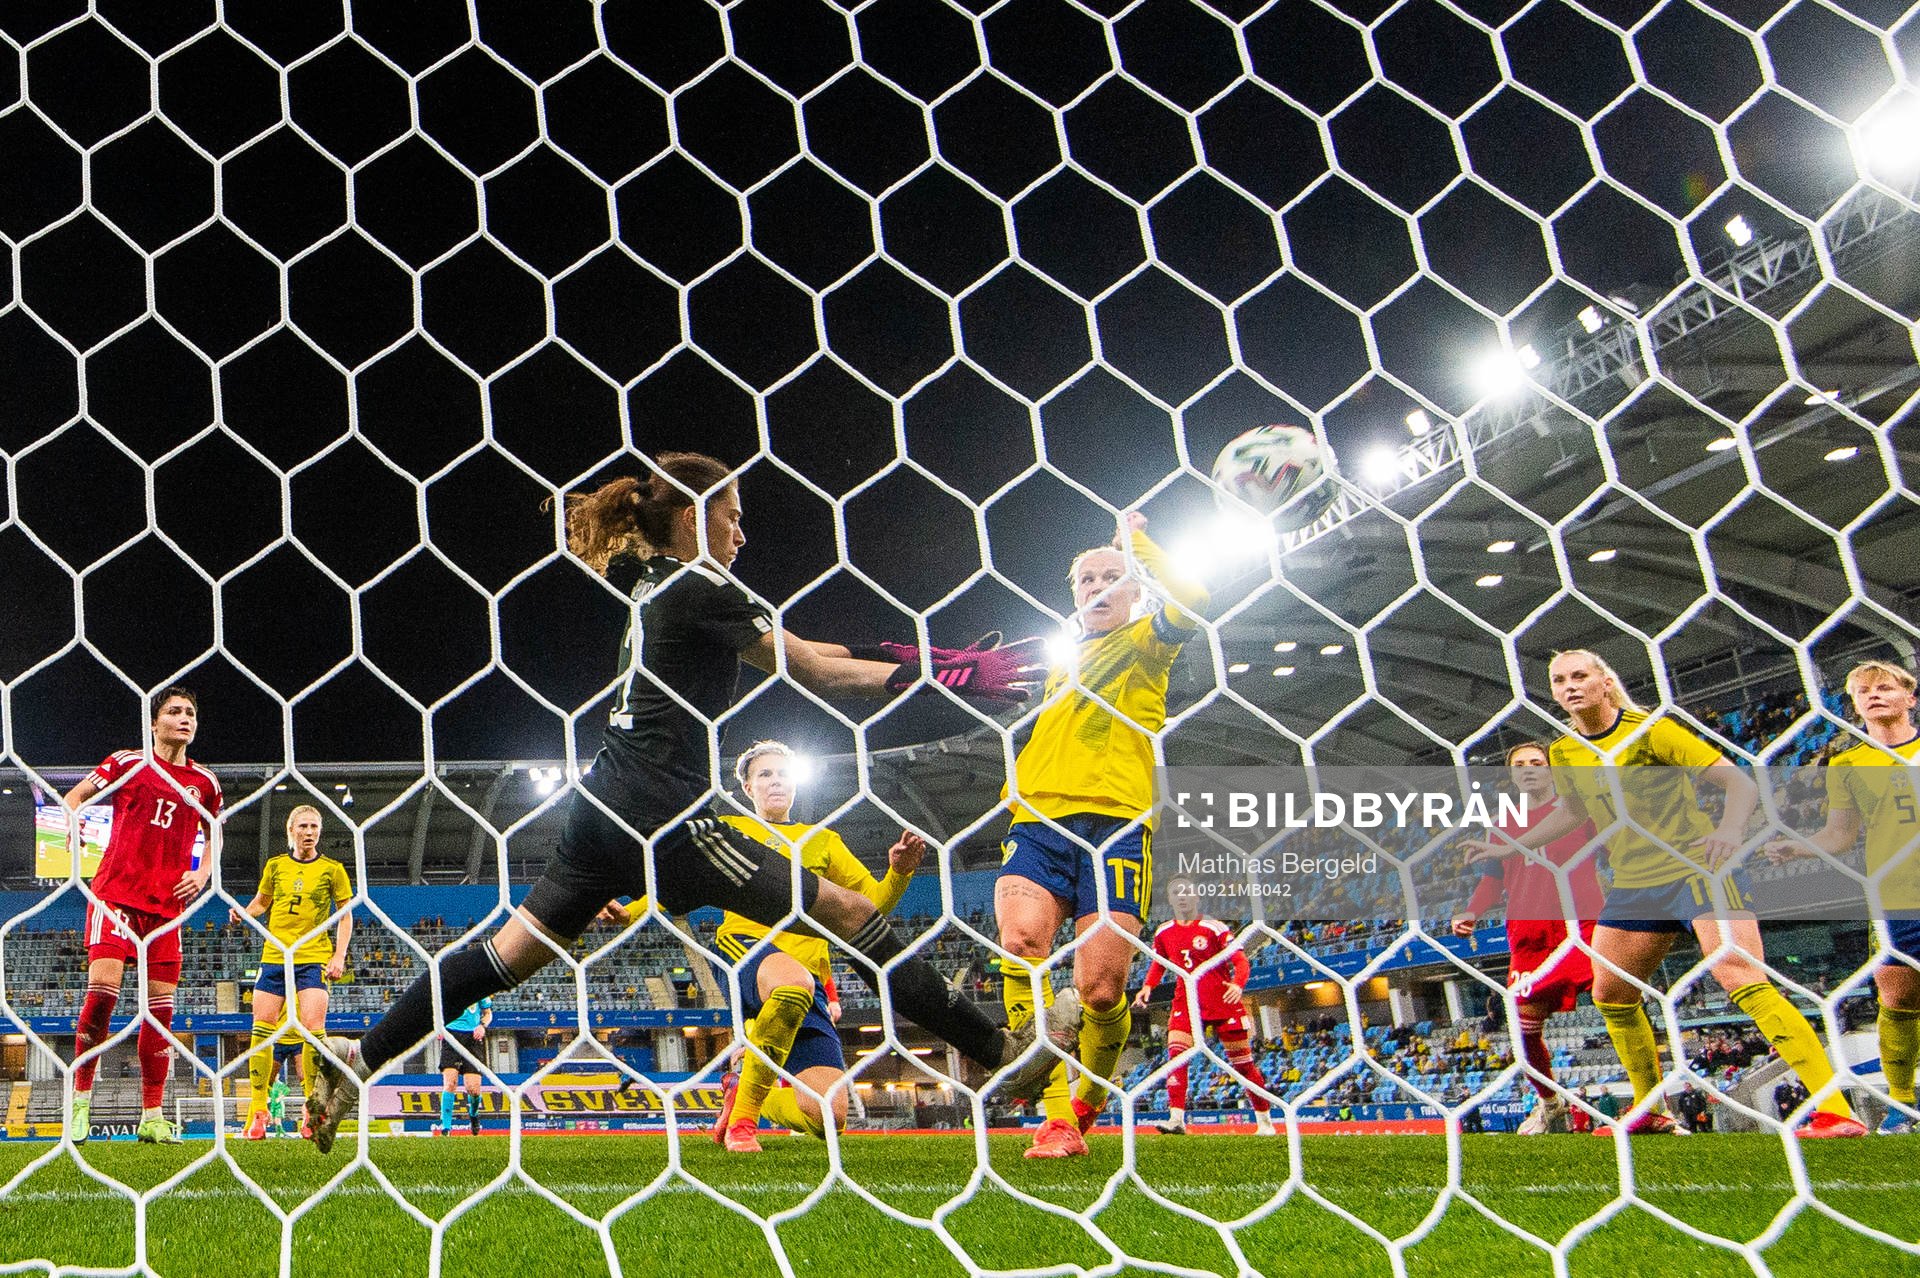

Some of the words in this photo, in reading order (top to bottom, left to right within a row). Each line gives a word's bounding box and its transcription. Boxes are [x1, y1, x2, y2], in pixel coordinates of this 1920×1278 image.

[150, 798, 178, 829] 13
[1894, 795, 1917, 824] 5
[1107, 858, 1141, 903] 17
[288, 894, 302, 915] 2
[1180, 950, 1193, 969] 3
[541, 1089, 725, 1111] SVERIG
